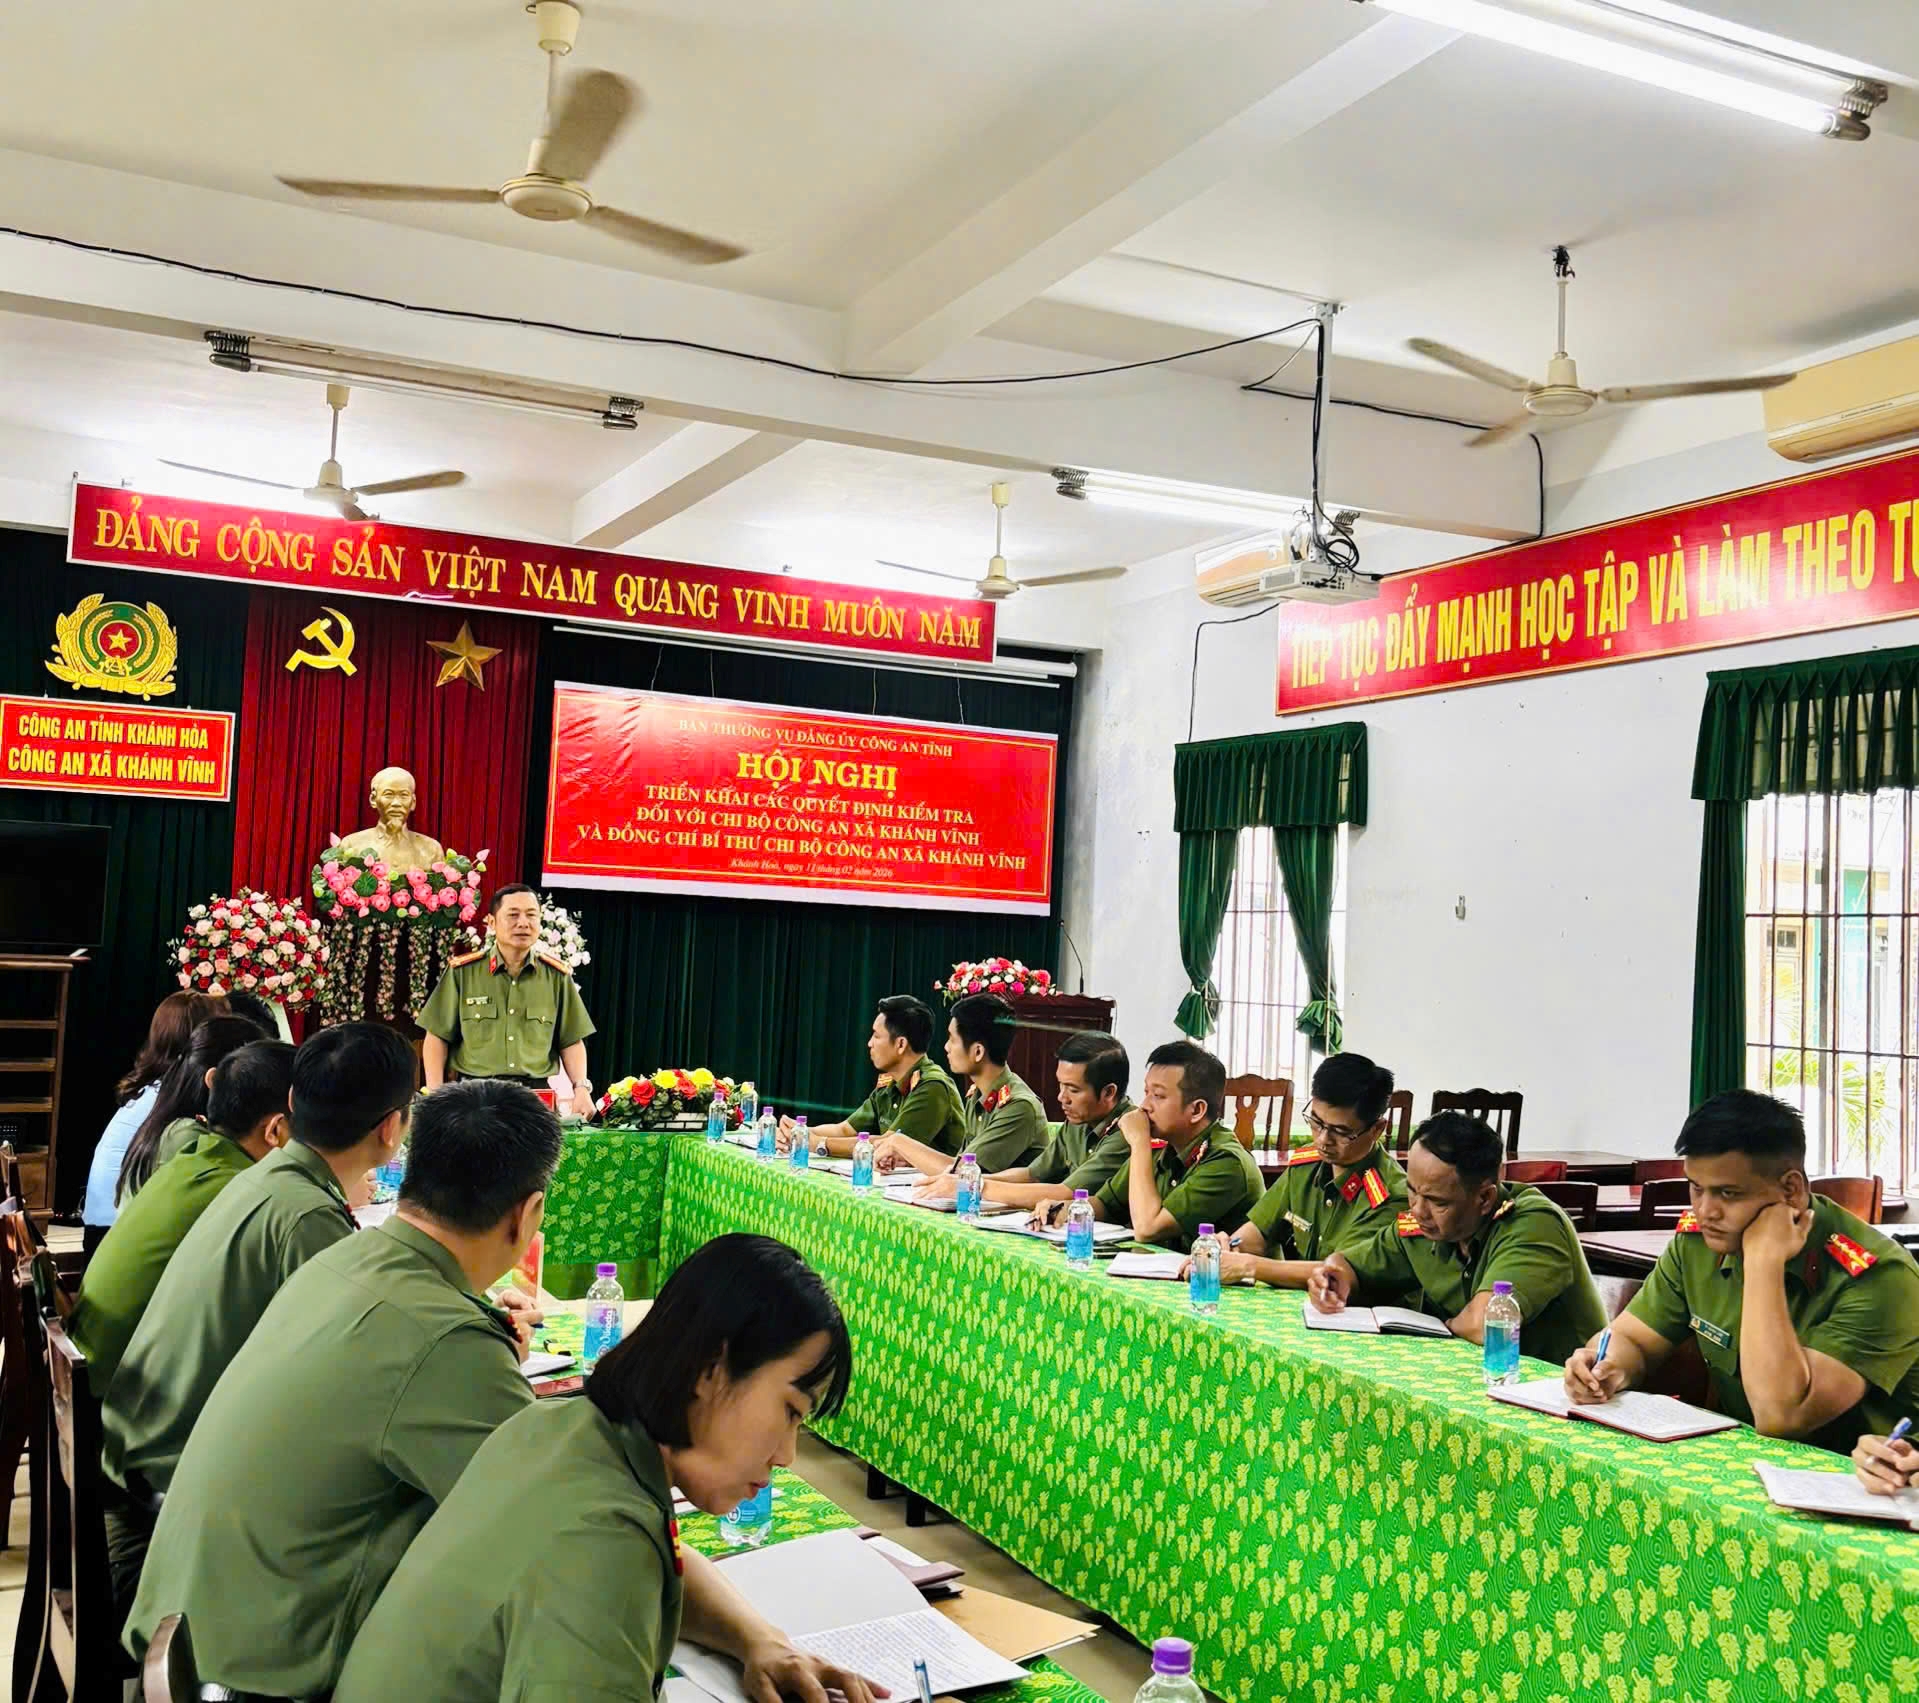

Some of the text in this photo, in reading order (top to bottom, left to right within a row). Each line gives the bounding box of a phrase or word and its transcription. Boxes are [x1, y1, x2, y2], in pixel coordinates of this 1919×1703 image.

[94, 496, 983, 649] ĐẢNG CỘNG SẢN VIỆT NAM QUANG VINH MUÔN NĂM
[1340, 616, 1379, 691] TỤC
[1385, 583, 1431, 672] ĐẨY
[1436, 587, 1513, 673] MẠNH
[1520, 574, 1575, 660] HỌC
[1584, 550, 1640, 650] TẬP
[1649, 535, 1688, 625] VÀ
[1699, 524, 1771, 616] LÀM
[1782, 509, 1876, 600] THEO
[18, 712, 209, 749] CÔNG AN TỈNH KHÁNH HÒA
[679, 719, 706, 732] BAN
[776, 728, 795, 744] VỤ
[797, 728, 835, 747] ĐẢNG
[860, 735, 898, 752] CÔNG
[899, 739, 919, 753] AN
[8, 744, 216, 784] CÔNG AN XÃ KHÁNH VĨNH
[736, 748, 897, 799] HỘI NGHỊ
[637, 801, 980, 846] ĐỐI VỚI CHI BỘ CÔNG AN XÃ KHÁNH VĨNH
[645, 781, 975, 825] TRIỂN KHAI CÁC QUYẾT ĐỊNH KIỂM TRA
[577, 821, 1026, 870] VÀ ĐỒNG CHÍ BÍ THƯ CHI BỘ CÔNG AN XÃ KHÁNH VĨNH
[873, 867, 893, 877] 2026
